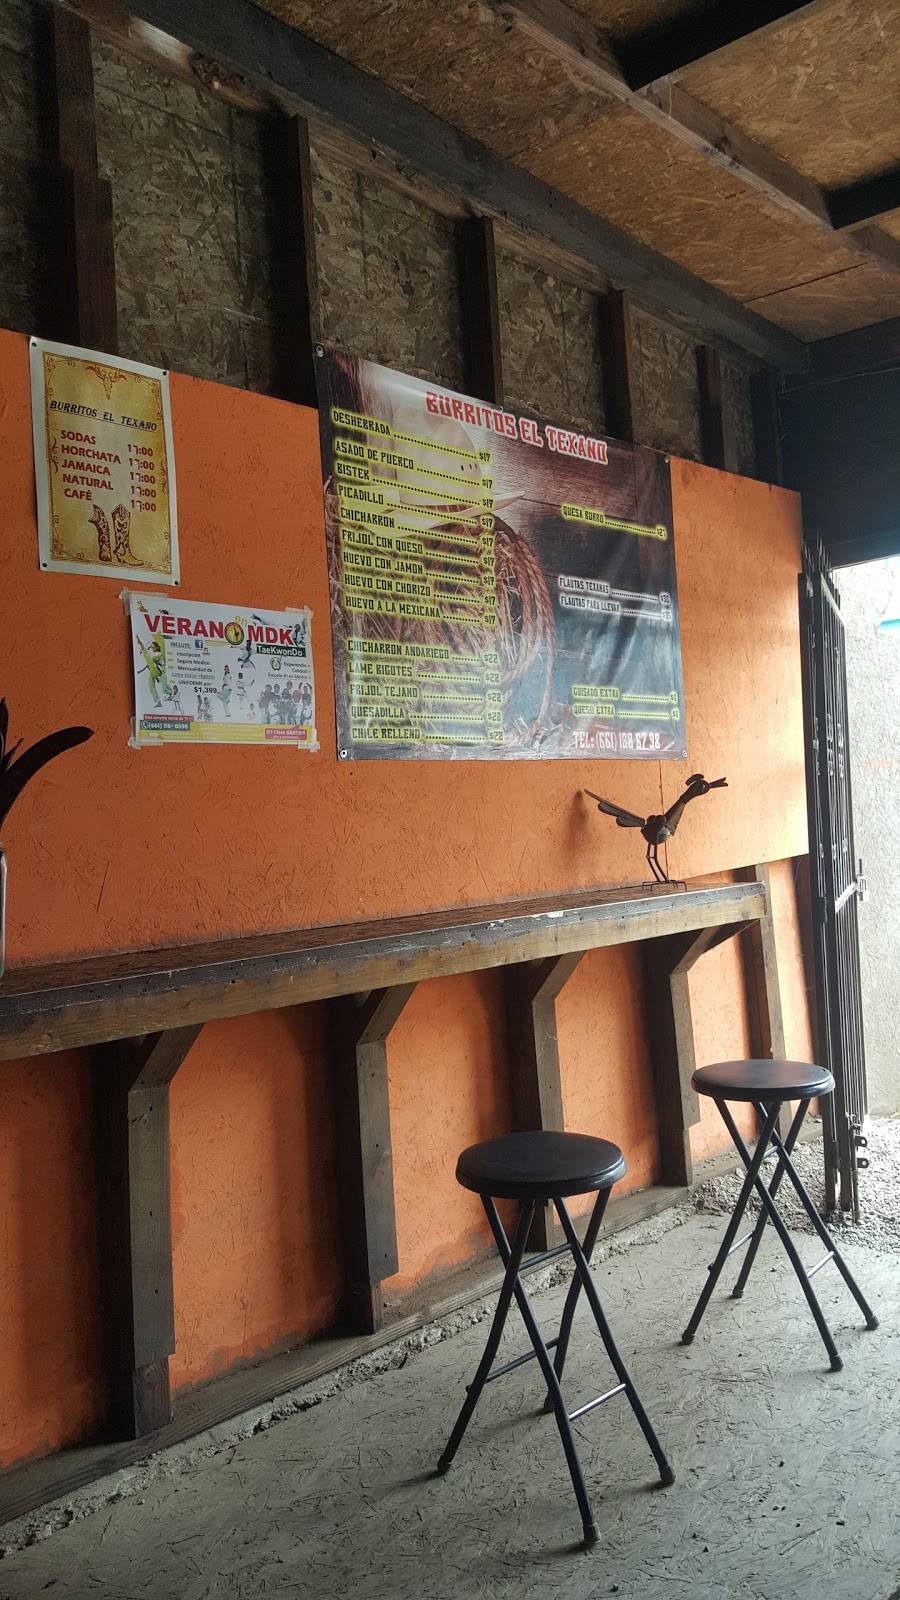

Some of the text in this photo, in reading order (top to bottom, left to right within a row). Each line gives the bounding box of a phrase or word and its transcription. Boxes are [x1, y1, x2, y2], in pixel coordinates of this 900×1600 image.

[50, 400, 157, 432] BURRITOS EL TEXANO
[60, 430, 97, 445] SODAS
[333, 410, 491, 463] DESHEBRADA $17
[519, 418, 543, 446] EL
[545, 426, 608, 464] TEXANO
[61, 444, 121, 464] HORCHATA
[61, 459, 111, 476] JAMAICA
[336, 440, 493, 489] ASADO DE PUERCO $17
[62, 473, 114, 491] NATURAL
[337, 462, 494, 509] BISTEK $17
[63, 487, 93, 501] CAFÉ
[338, 485, 493, 528] PICADILLO $17
[562, 505, 583, 519] QUESA
[584, 510, 604, 524] BURRO
[340, 507, 494, 547] CHICHARRON $17
[342, 529, 495, 567] FRIJOL CON QUESO $17
[343, 551, 495, 586] HUEVO CON JAMON $17
[344, 574, 496, 606] HUEVO CON CHORIZO $17
[559, 577, 585, 590] FLAUTAS
[586, 581, 609, 594] TEXANAS
[345, 596, 496, 625] HUEVO A LA MEXICANA $17
[561, 595, 586, 608] FLAUTAS
[586, 599, 600, 610] PARA
[601, 601, 620, 613] LLEVAR
[247, 624, 295, 646] MDK
[257, 646, 303, 657] TaeKwonDo
[347, 639, 498, 664] CHICHARRON ANDARIEGO $22
[349, 662, 499, 683] LAME BIGOTES $22
[193, 686, 218, 694] $1,399
[350, 684, 501, 703] FRIJOL TEJANO $22
[600, 688, 619, 699] EXTRA
[351, 705, 502, 722] QUESADILLA $22
[573, 704, 595, 715] QUESO
[596, 706, 615, 716] EXTRA
[352, 728, 503, 740] CHILE RELLENO $22
[572, 731, 594, 749] TEL:
[596, 731, 617, 752] (661)
